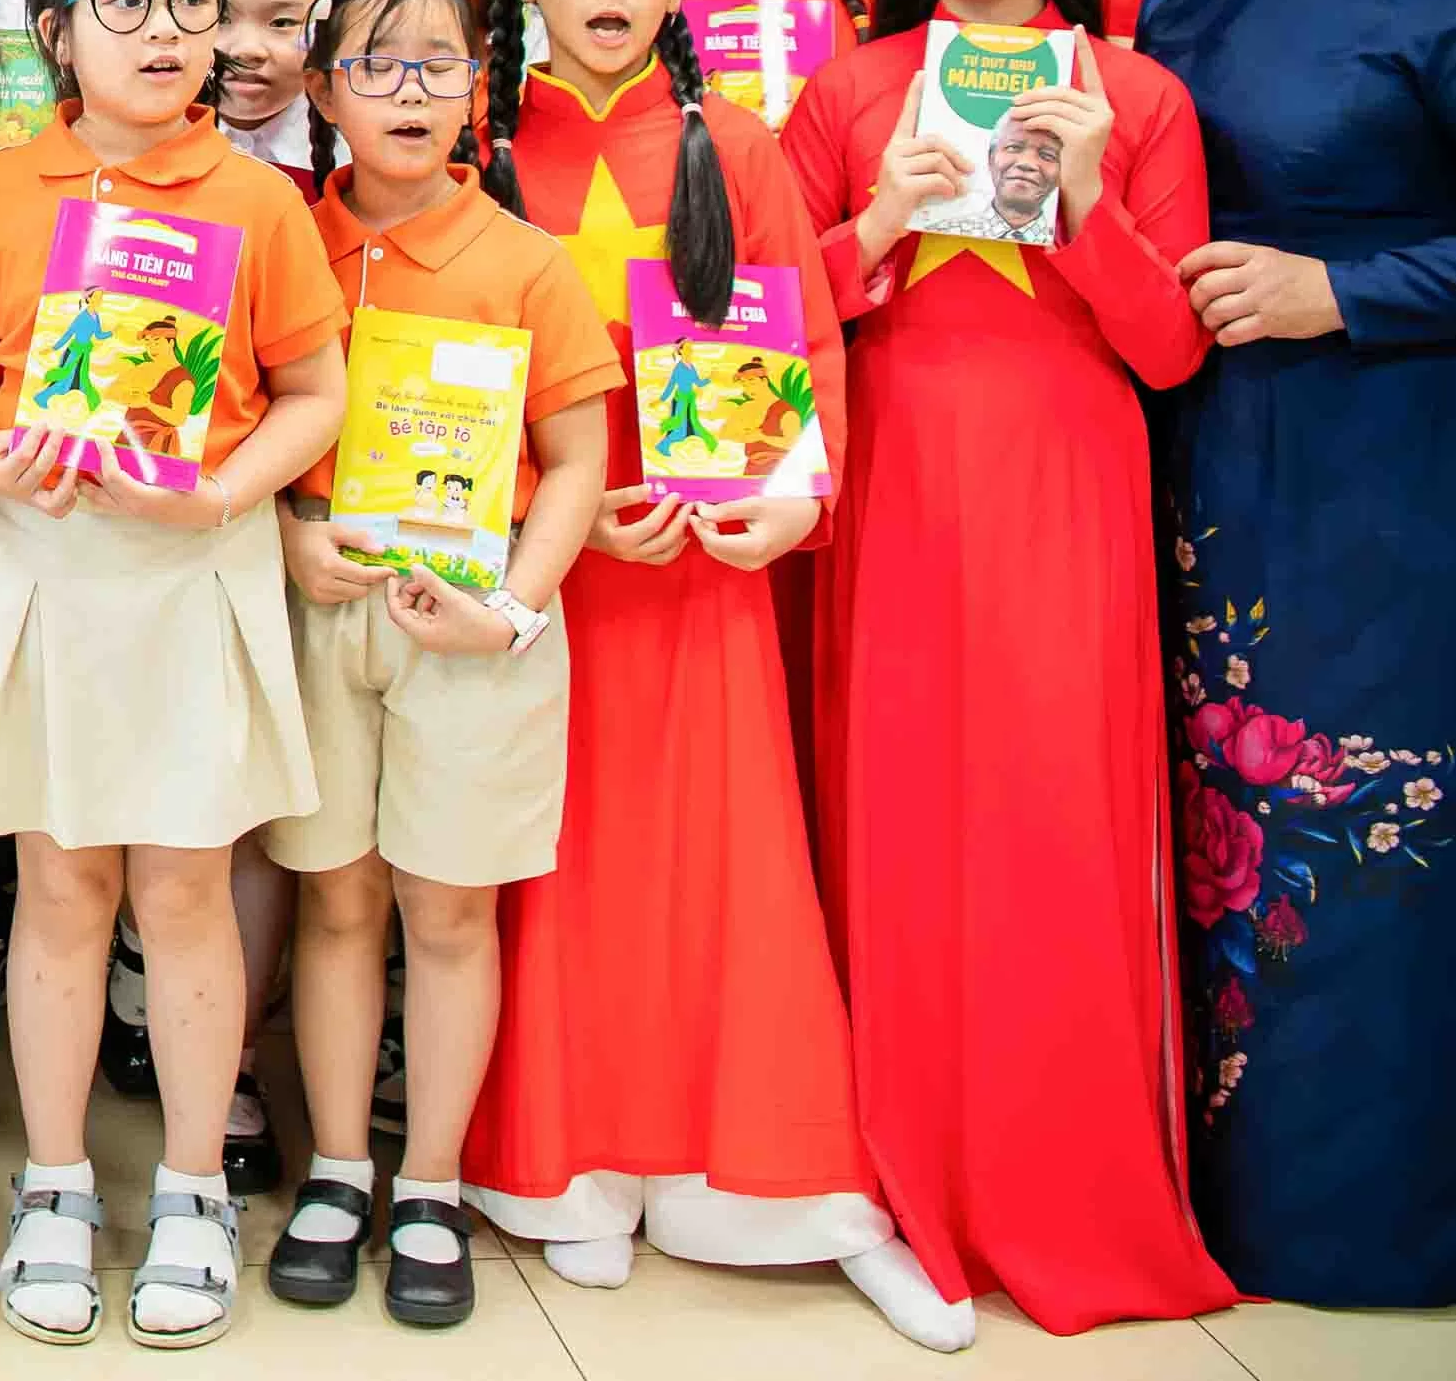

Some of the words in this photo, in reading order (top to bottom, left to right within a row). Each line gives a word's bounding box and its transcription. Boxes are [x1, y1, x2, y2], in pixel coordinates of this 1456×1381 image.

[946, 67, 1047, 93] MANDELA
[133, 252, 165, 275] TIÊN
[166, 260, 194, 281] CUA
